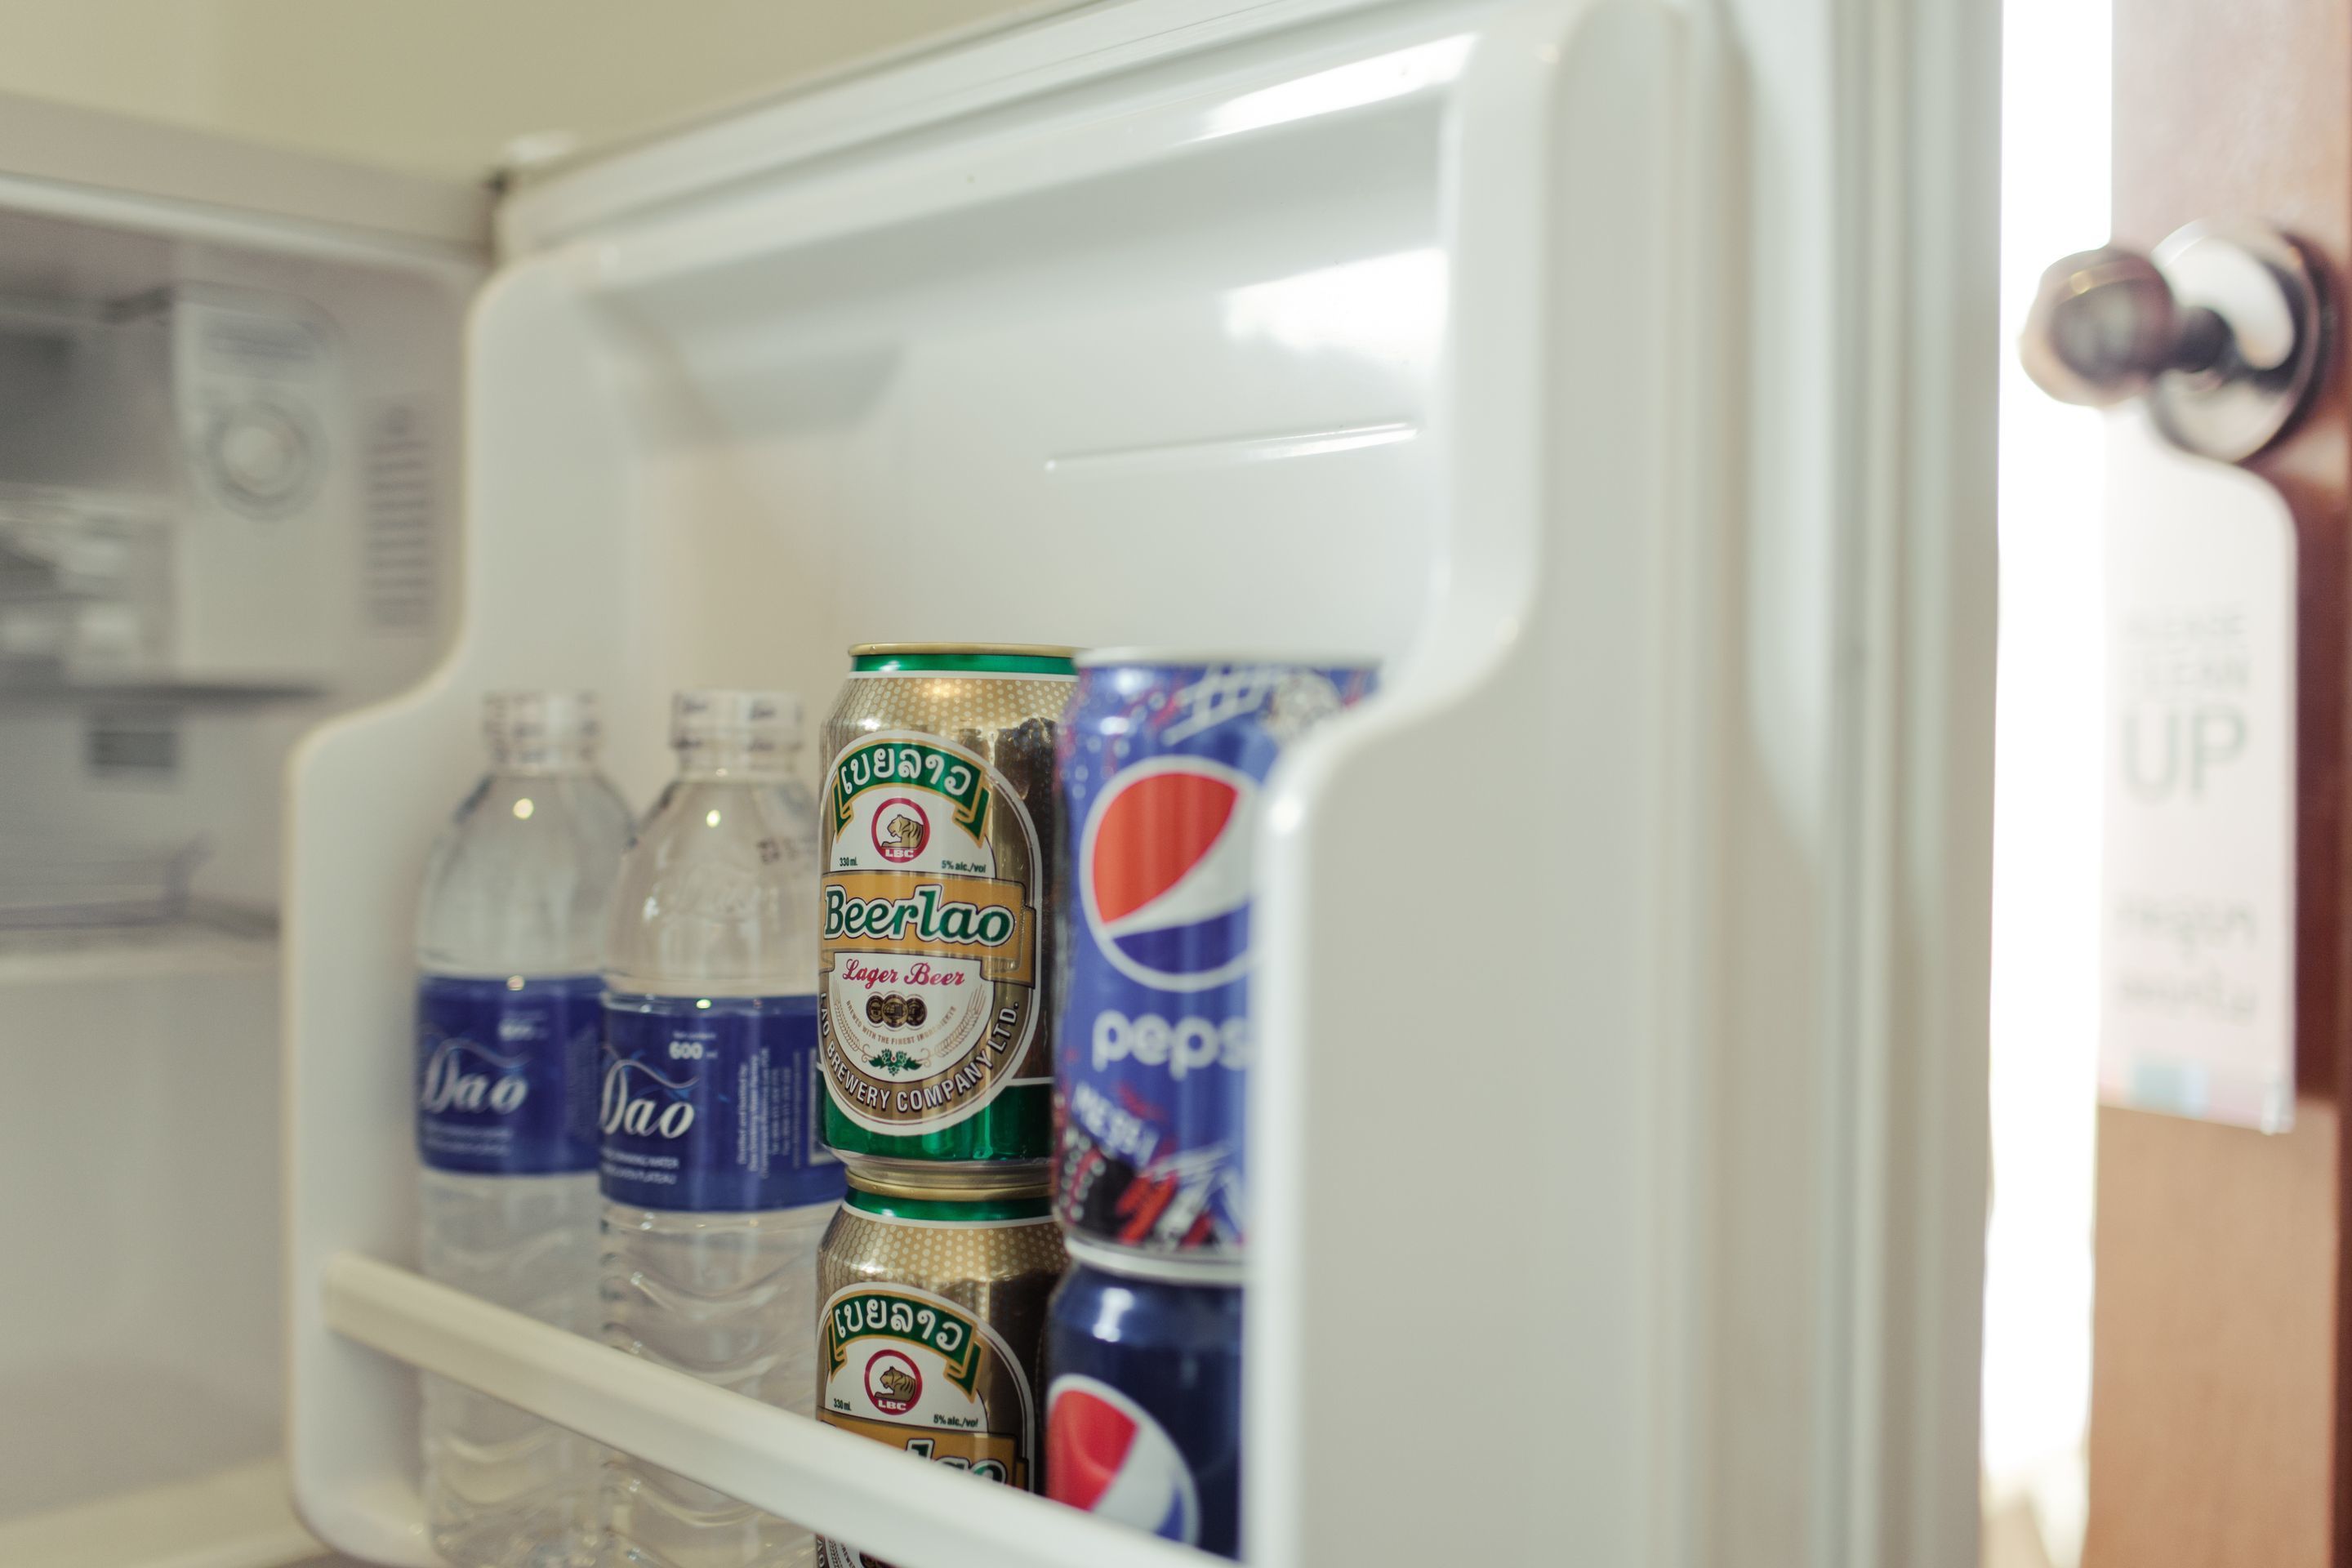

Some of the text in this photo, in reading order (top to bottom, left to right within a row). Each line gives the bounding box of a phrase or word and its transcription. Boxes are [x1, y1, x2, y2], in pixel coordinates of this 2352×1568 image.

[2123, 704, 2249, 803] UP
[839, 857, 850, 866] 330
[884, 849, 914, 858] LBC
[941, 859, 954, 870] 5%
[823, 888, 1013, 945] Beerlao
[842, 958, 965, 990] Lager Beer
[846, 1000, 862, 1027] BREWED
[862, 1026, 876, 1040] WITH
[878, 1034, 889, 1045] THE
[891, 1036, 915, 1045] FINEST
[669, 1040, 704, 1060] 600
[820, 992, 831, 1038] LAO
[826, 1040, 891, 1110] BREWERY
[897, 1049, 994, 1113] COMPANY
[987, 1001, 1019, 1054] LTD.
[1092, 1009, 1252, 1081] peps
[421, 1038, 529, 1115] Dao
[601, 1059, 695, 1139] Dao
[833, 1397, 844, 1410] 330
[878, 1399, 906, 1411] LBC
[933, 1414, 946, 1425] 5%
